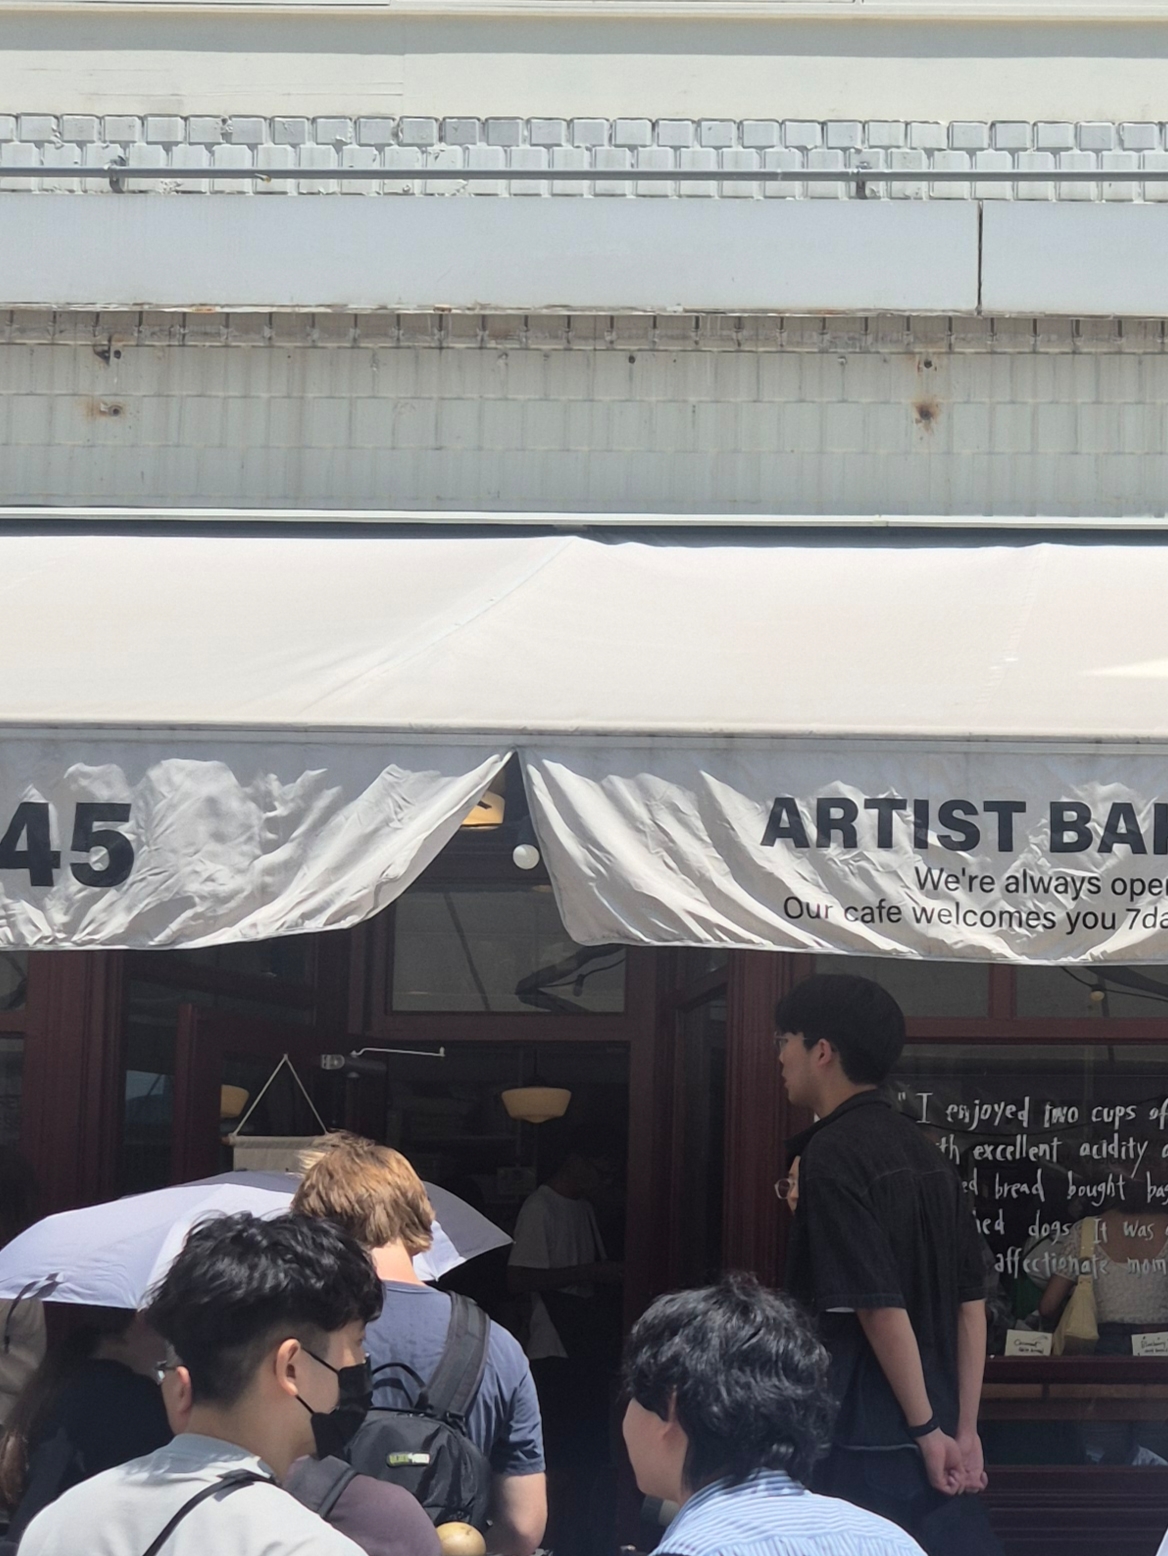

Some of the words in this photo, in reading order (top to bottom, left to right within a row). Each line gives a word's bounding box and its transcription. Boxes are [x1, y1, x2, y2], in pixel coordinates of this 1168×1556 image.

[0, 801, 136, 888] 45
[761, 797, 1027, 853] ARTIST
[914, 866, 996, 893] We're
[1004, 868, 1101, 901] always
[783, 896, 833, 920] Our
[843, 898, 902, 924] cafe
[912, 901, 1057, 930] welcomes
[1065, 909, 1117, 935] you
[946, 1096, 1030, 1131] enjoyed
[1043, 1101, 1079, 1128] two
[1091, 1105, 1137, 1130] cups
[973, 1134, 1063, 1163] excellent
[1079, 1132, 1149, 1179] acidity
[995, 1168, 1045, 1202] bread
[1066, 1170, 1126, 1207] bought
[1093, 1217, 1108, 1245] It
[994, 1246, 1109, 1279] affectionate
